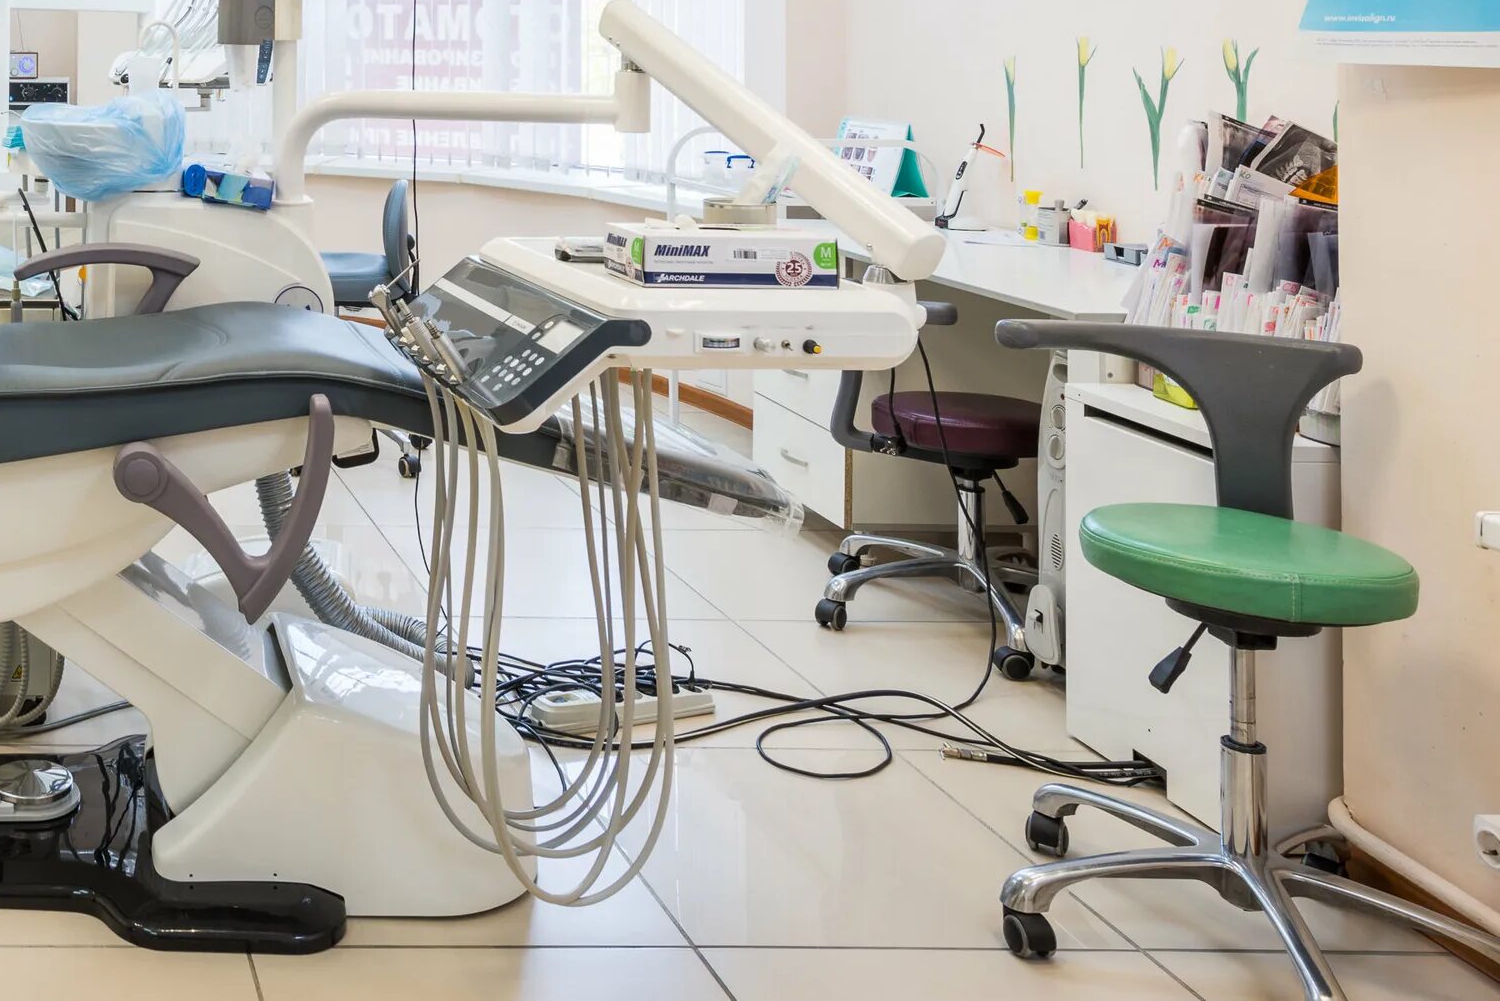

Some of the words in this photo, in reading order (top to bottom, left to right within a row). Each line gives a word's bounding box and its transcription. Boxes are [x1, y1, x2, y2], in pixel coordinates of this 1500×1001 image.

[1323, 12, 1396, 25] www.invisalign.ru
[654, 244, 711, 257] MiniMAX
[820, 246, 832, 258] M
[786, 262, 802, 273] 25
[664, 274, 705, 282] ARCHDALE
